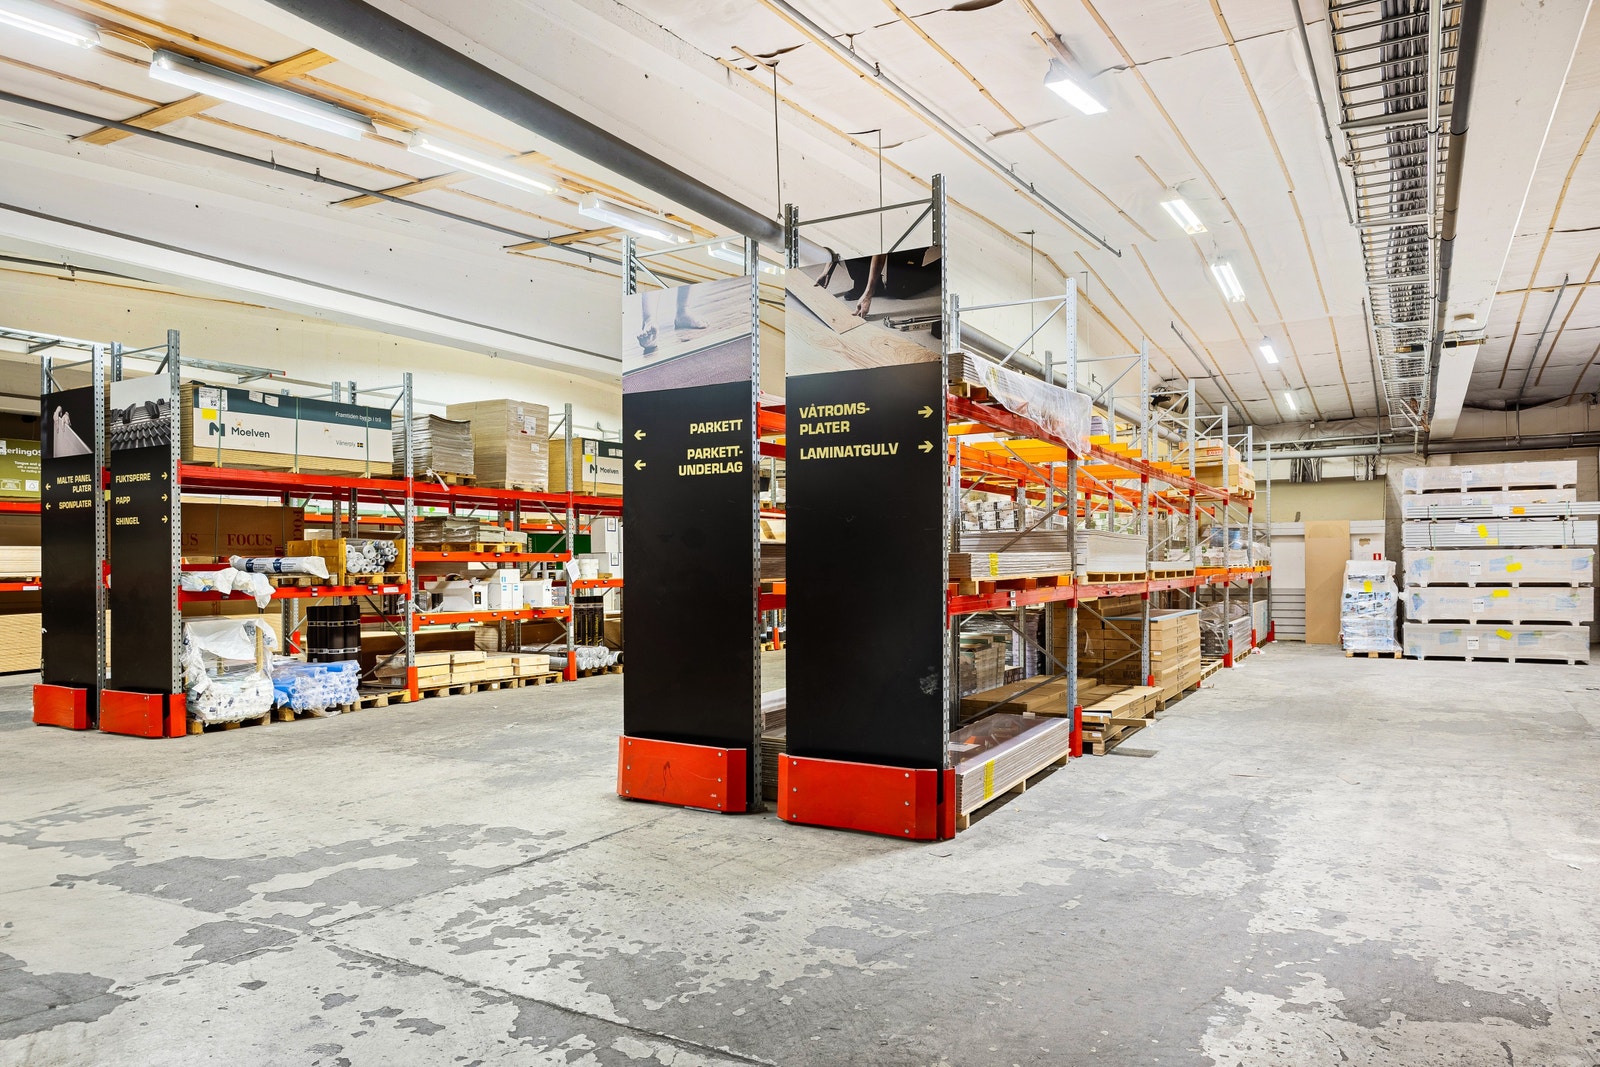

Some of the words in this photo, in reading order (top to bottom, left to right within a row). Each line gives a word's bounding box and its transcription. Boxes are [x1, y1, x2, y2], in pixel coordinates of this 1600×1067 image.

[799, 403, 870, 419] VÅTROMS-
[231, 427, 270, 438] Moelven
[690, 419, 743, 434] PARKETT
[799, 420, 850, 435] PLATER
[687, 445, 743, 460] PARKETT-
[800, 442, 899, 460] LAMINATGULV
[678, 461, 743, 476] UNDERLAG
[56, 475, 74, 485] MALTE
[74, 474, 92, 483] PANEL
[115, 473, 151, 483] FUKTSPERRE
[72, 484, 92, 493] PLATER
[58, 500, 92, 510] SPONPLATER
[115, 496, 131, 505] PAPP
[115, 517, 140, 525] SHINGEL
[227, 533, 273, 546] FOCUS
